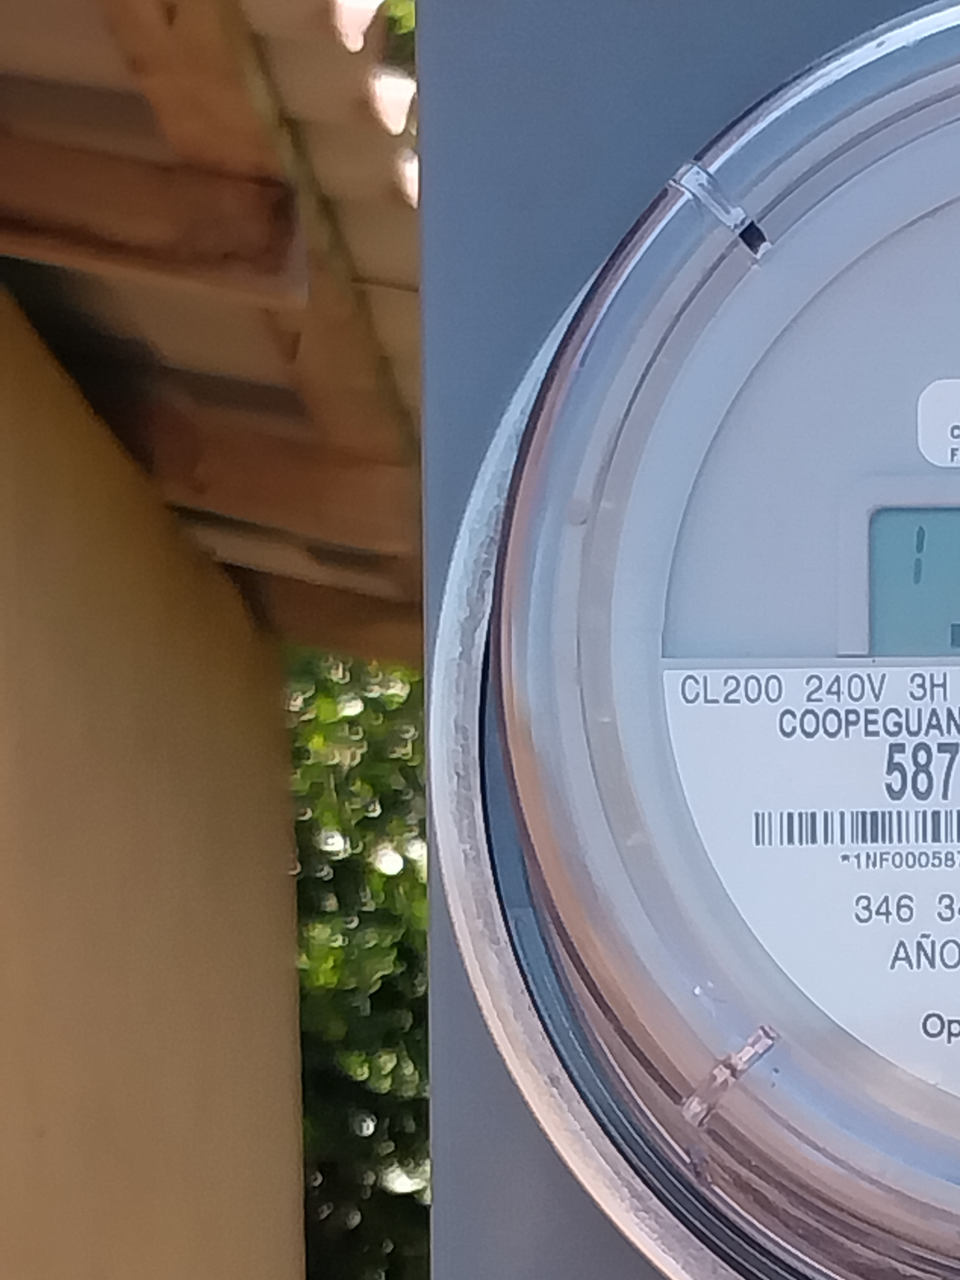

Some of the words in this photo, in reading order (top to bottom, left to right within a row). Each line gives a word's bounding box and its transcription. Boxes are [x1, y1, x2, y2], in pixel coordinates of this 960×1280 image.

[680, 673, 784, 704] CL200
[805, 672, 886, 702] 240V
[909, 671, 949, 702] 3H
[854, 894, 916, 924] 346
